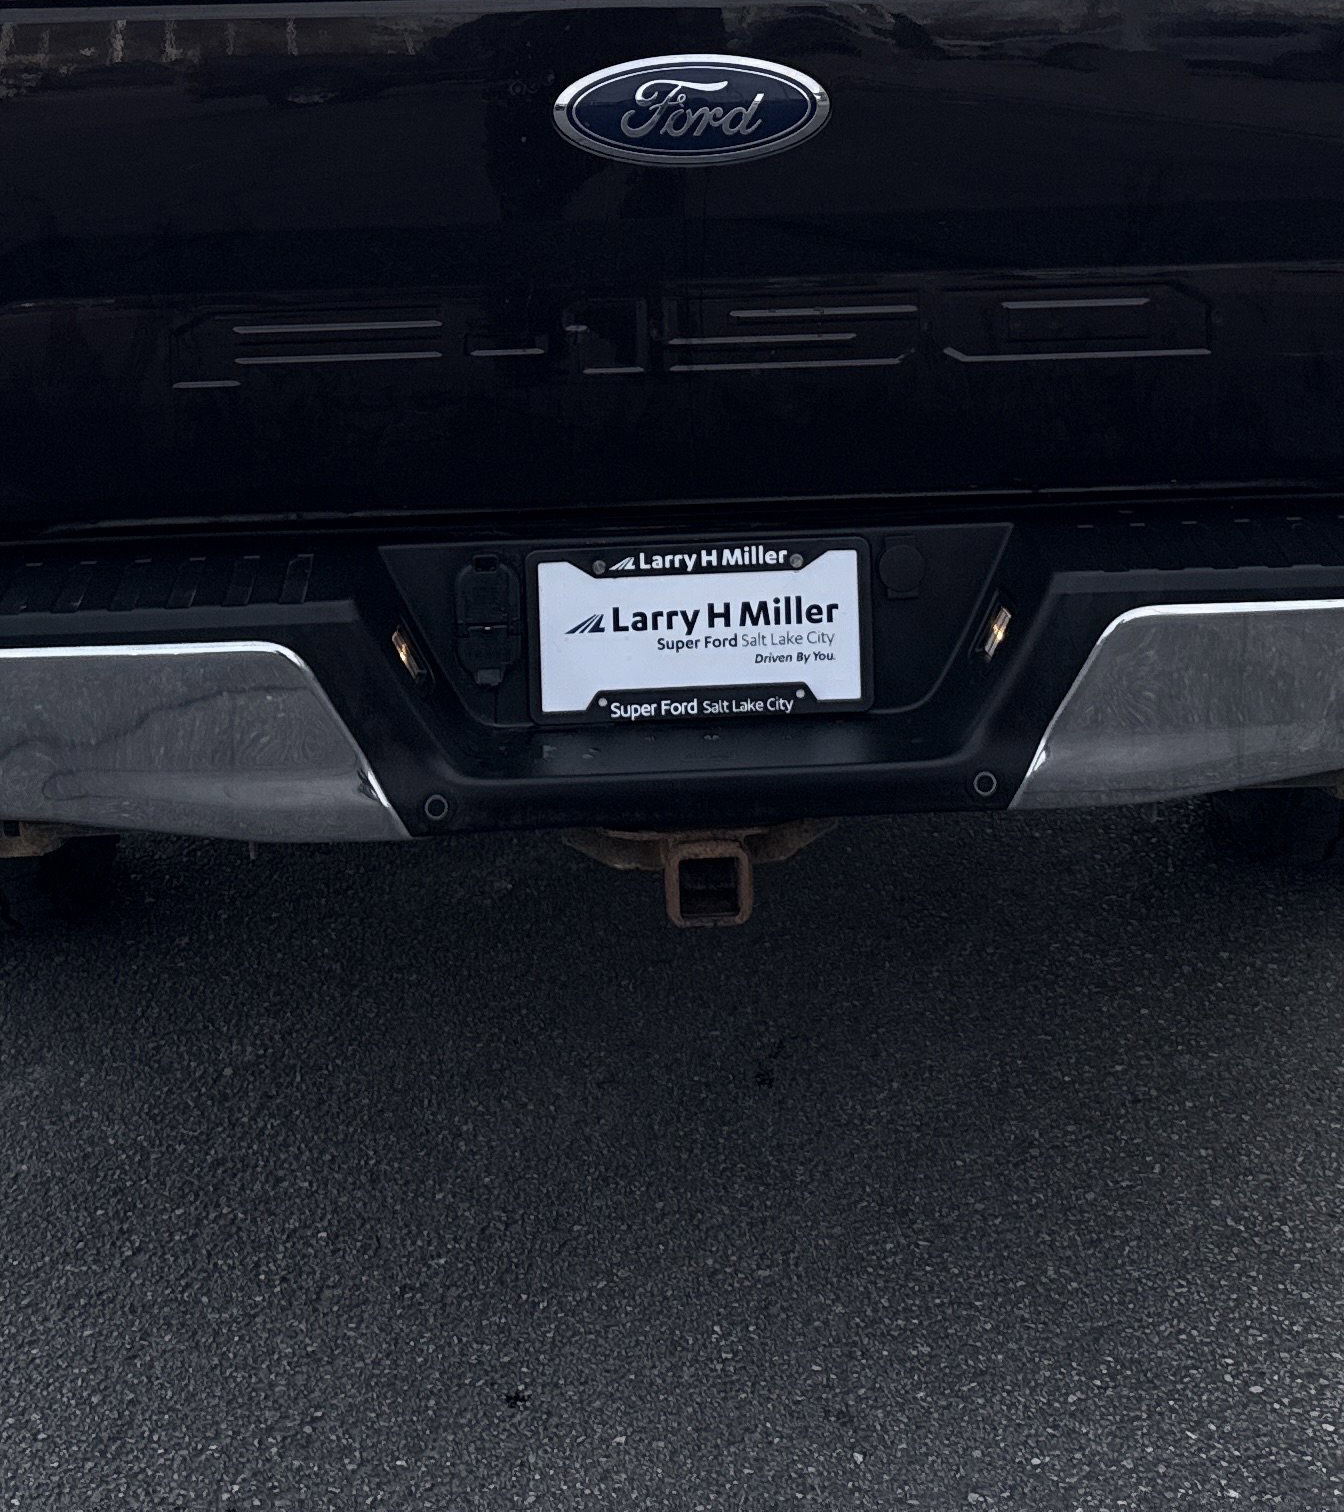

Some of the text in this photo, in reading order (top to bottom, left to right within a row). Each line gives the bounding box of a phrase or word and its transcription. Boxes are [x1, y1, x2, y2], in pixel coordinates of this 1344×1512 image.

[620, 78, 764, 138] Ford
[639, 546, 788, 572] Larry H Miller
[612, 596, 839, 636] Larry H Miller
[657, 630, 836, 653] Super Ford Salt Lake City
[754, 652, 793, 665] Driven
[796, 652, 811, 665] By
[611, 696, 795, 721] Super Ford Salt Lake City
